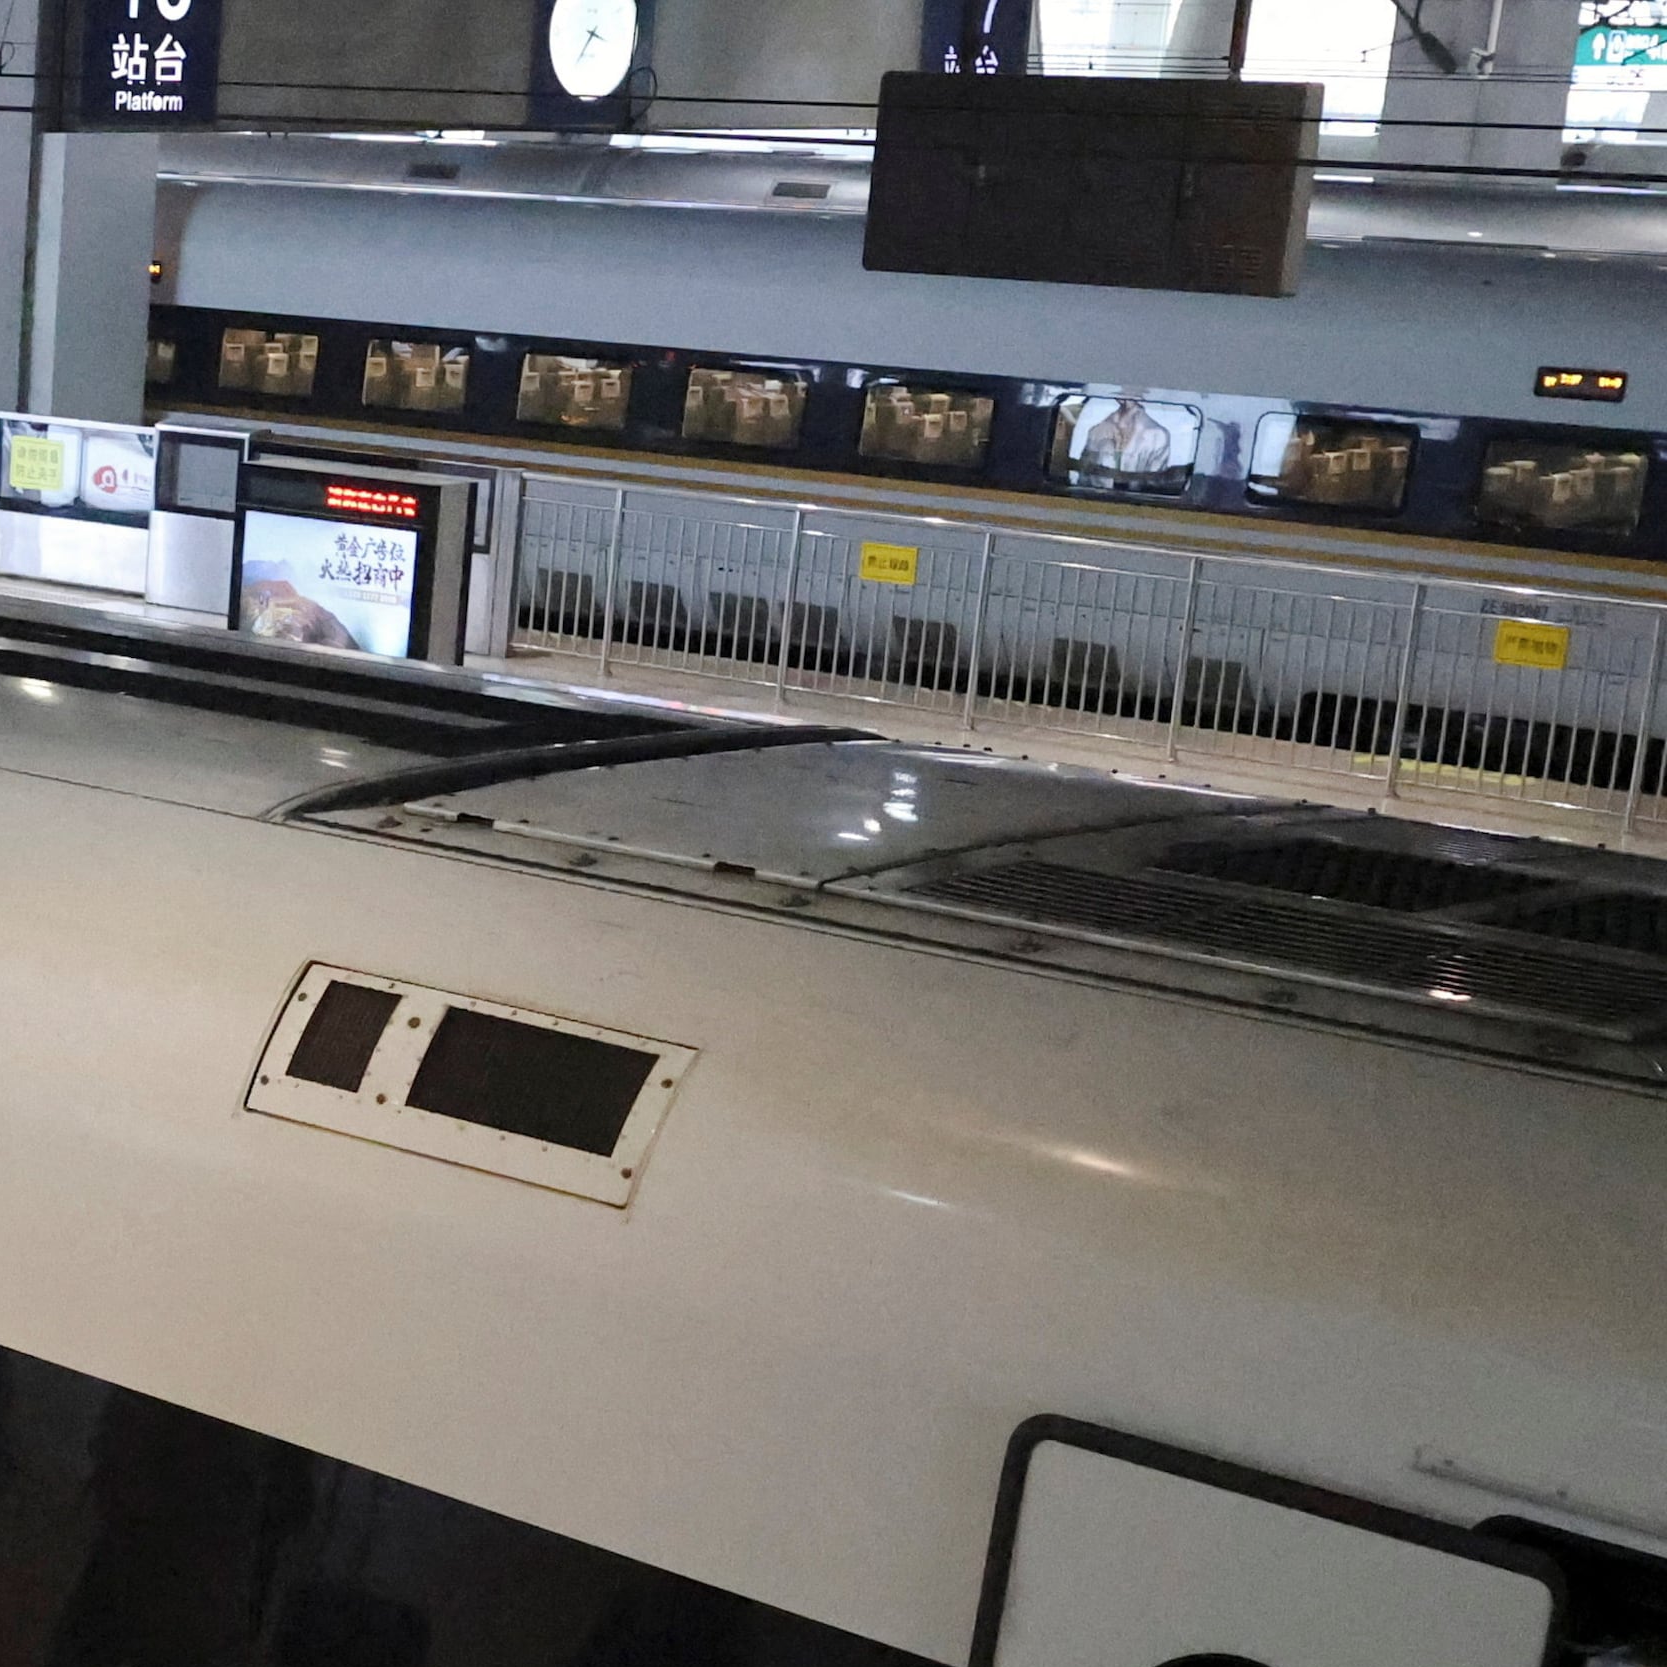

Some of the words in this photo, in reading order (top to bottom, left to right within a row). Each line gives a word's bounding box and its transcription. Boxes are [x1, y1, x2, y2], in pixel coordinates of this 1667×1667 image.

[111, 33, 187, 84] 站台
[115, 91, 183, 111] Platform
[334, 533, 405, 562] 黄金广告位
[318, 557, 404, 590] 火热招商中
